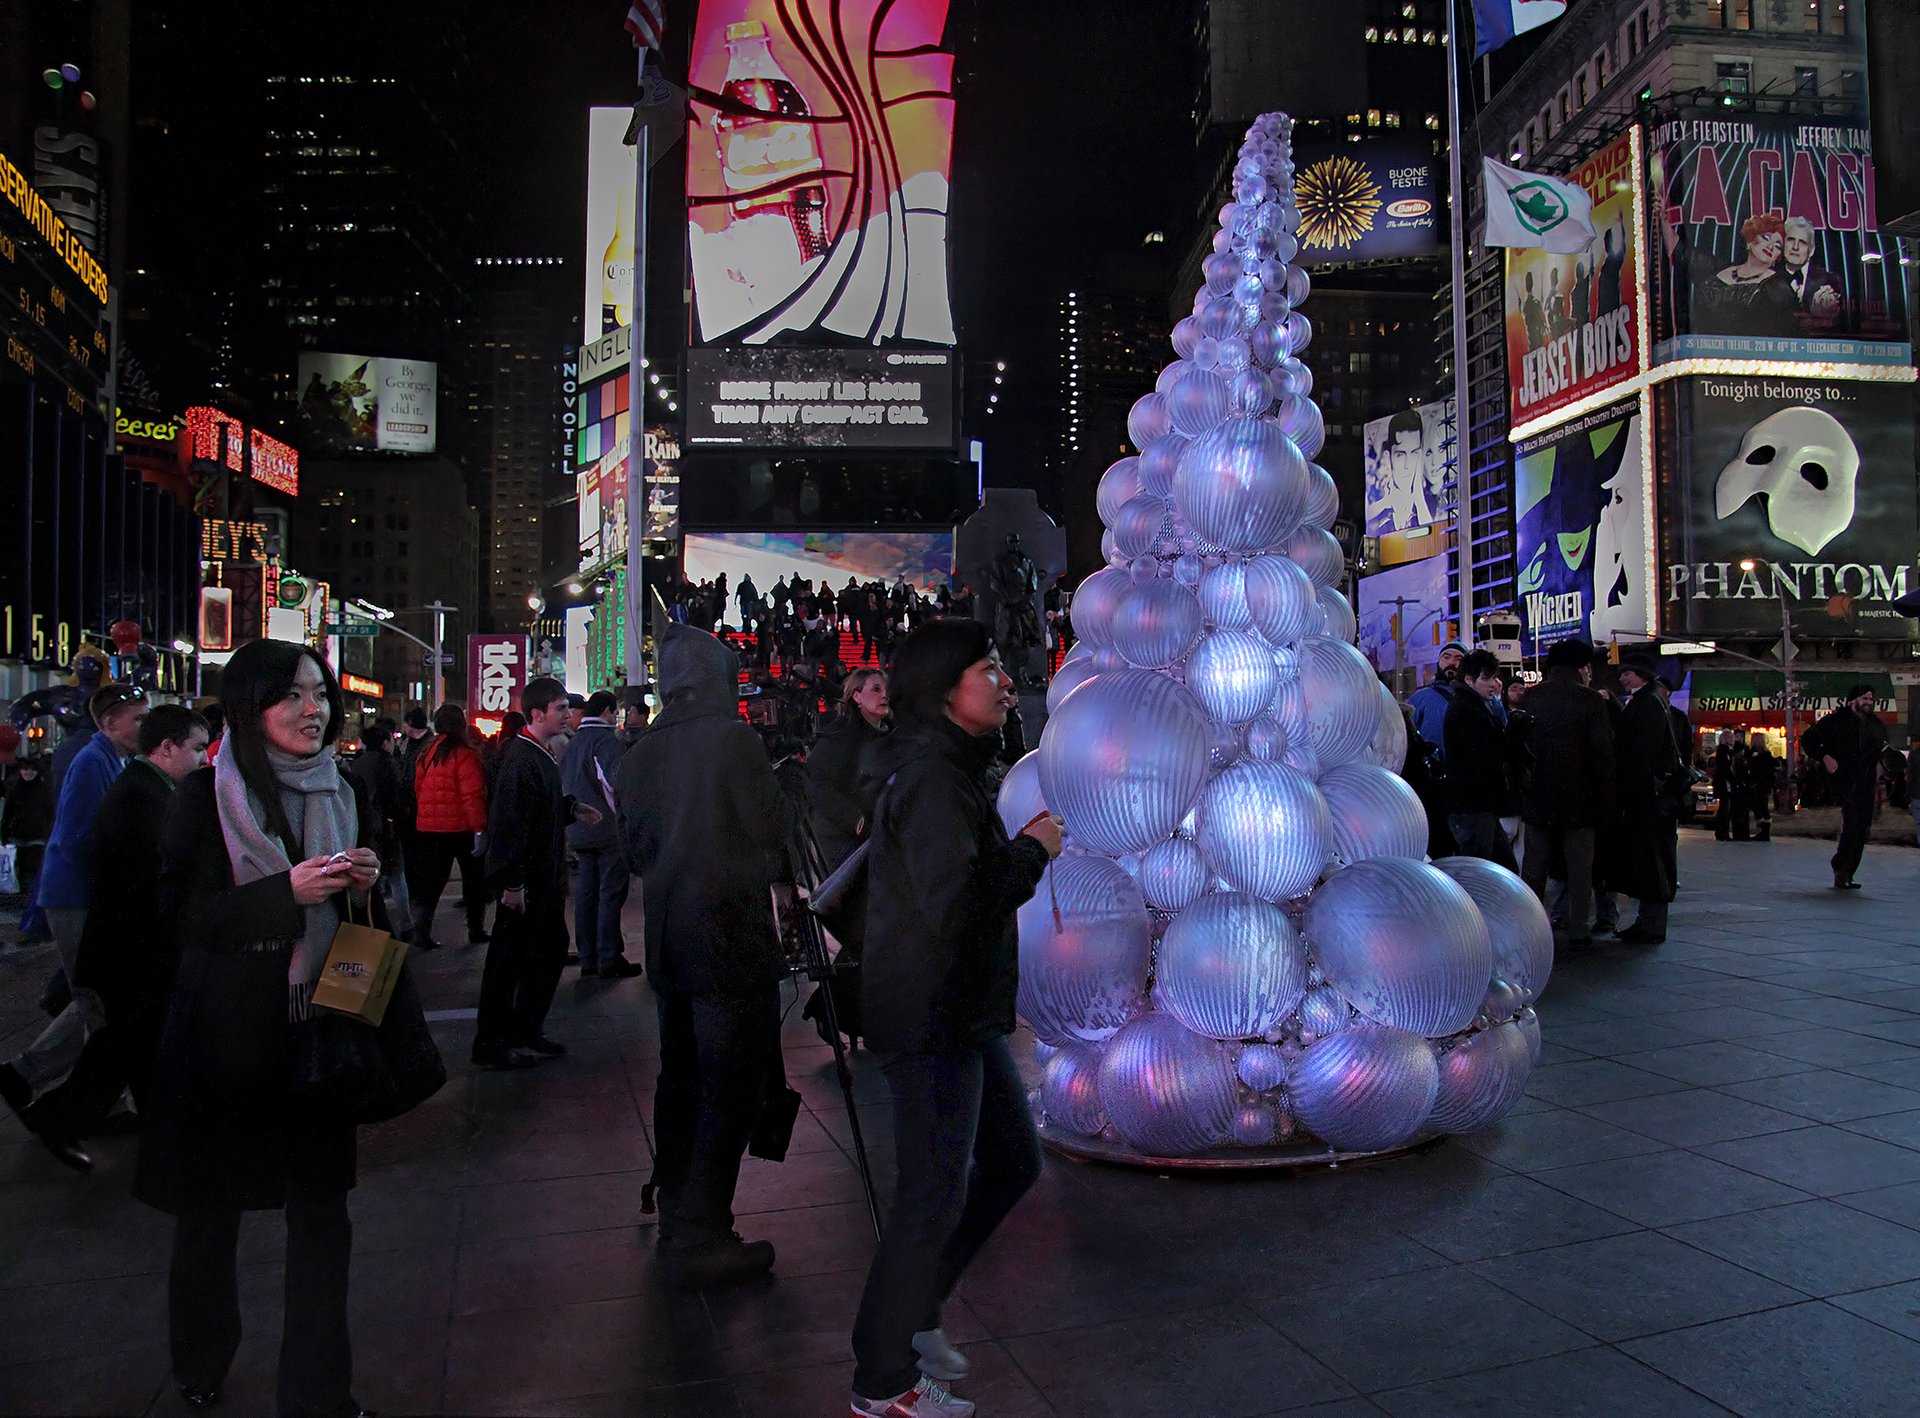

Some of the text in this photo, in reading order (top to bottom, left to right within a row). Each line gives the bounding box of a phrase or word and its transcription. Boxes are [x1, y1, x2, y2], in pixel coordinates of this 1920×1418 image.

[1693, 120, 1754, 145] FIERSTEIN
[1796, 126, 1841, 149] JEFFREY
[1389, 167, 1428, 179] BUONE
[1392, 177, 1427, 188] FESTE.
[65, 230, 108, 304] LEADERS
[1519, 304, 1632, 408] JERSEY BOYS
[402, 365, 416, 379] By
[720, 382, 771, 400] MORE
[774, 382, 831, 400] FRONT
[868, 382, 921, 400] ROOM
[1701, 380, 1759, 402] Tonight
[1764, 380, 1821, 404] belongs
[391, 403, 410, 416] did
[563, 363, 576, 474] NOVOTEL
[711, 405, 759, 424] THAN
[762, 405, 799, 424] ANY
[801, 405, 885, 424] COMPACT
[387, 422, 427, 433] LEADERSHIP
[1668, 562, 1910, 601] PHANTOM
[1864, 610, 1891, 618] MAJESTIC
[482, 641, 518, 712] tkts
[1698, 696, 1753, 710] sbarro
